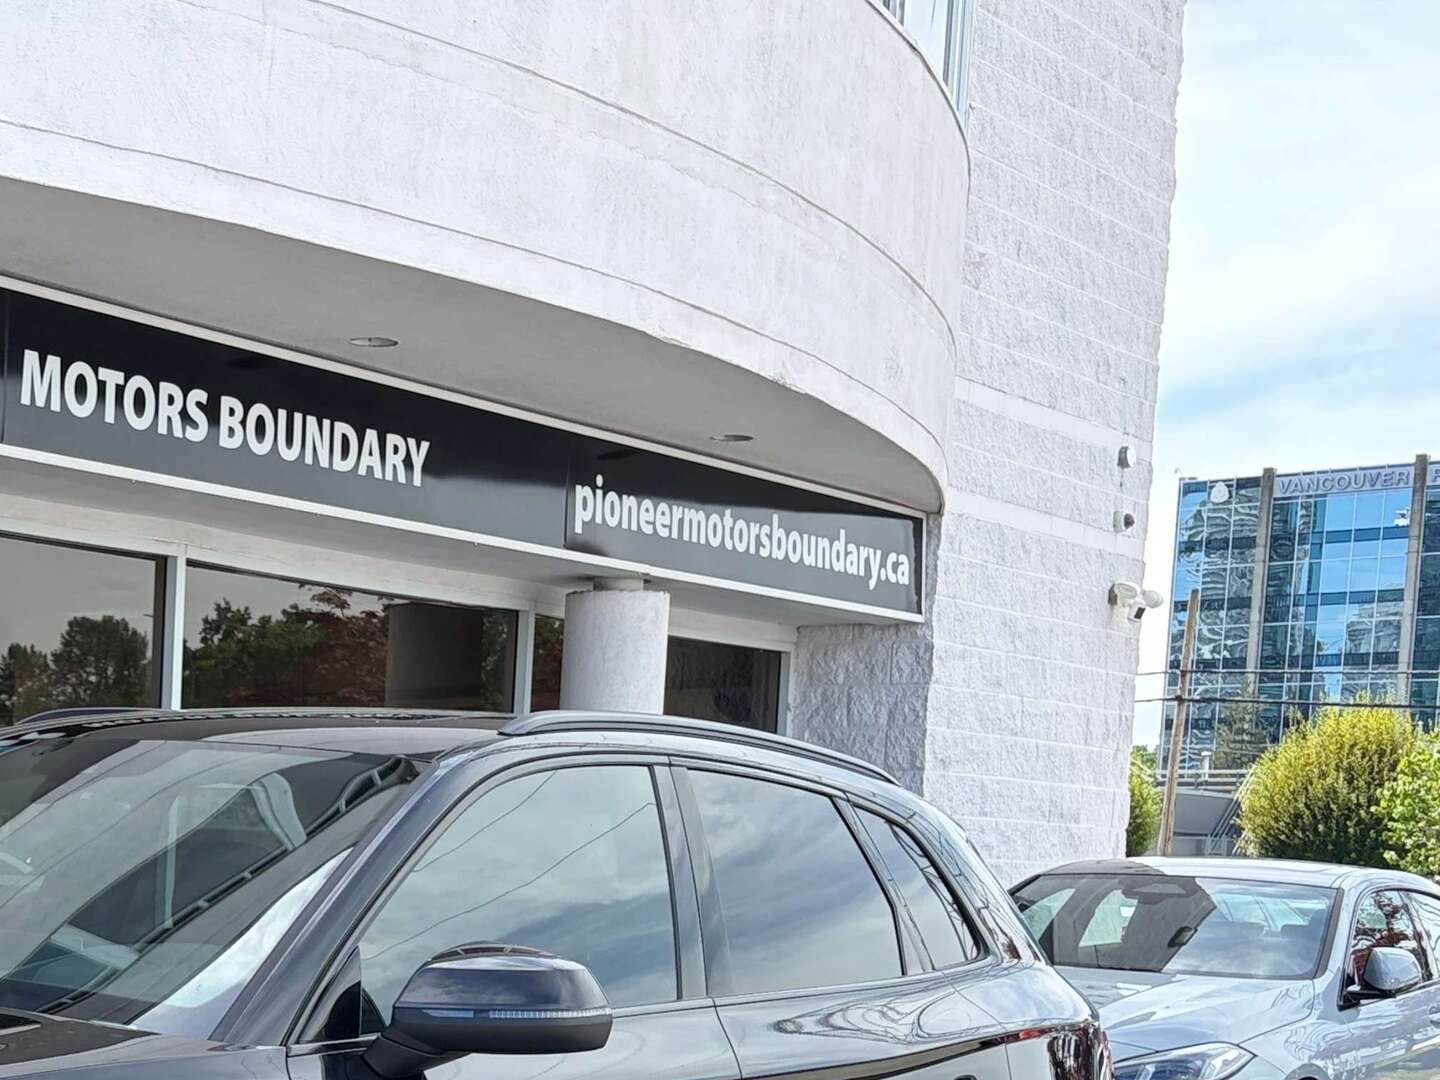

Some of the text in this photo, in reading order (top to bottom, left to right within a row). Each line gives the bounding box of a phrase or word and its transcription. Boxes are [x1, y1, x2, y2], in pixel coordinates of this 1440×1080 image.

[20, 349, 431, 488] MOTORS BOUNDARY
[574, 473, 910, 590] pioneermotorsboundary.ca
[1279, 470, 1410, 495] VANCOUVER
